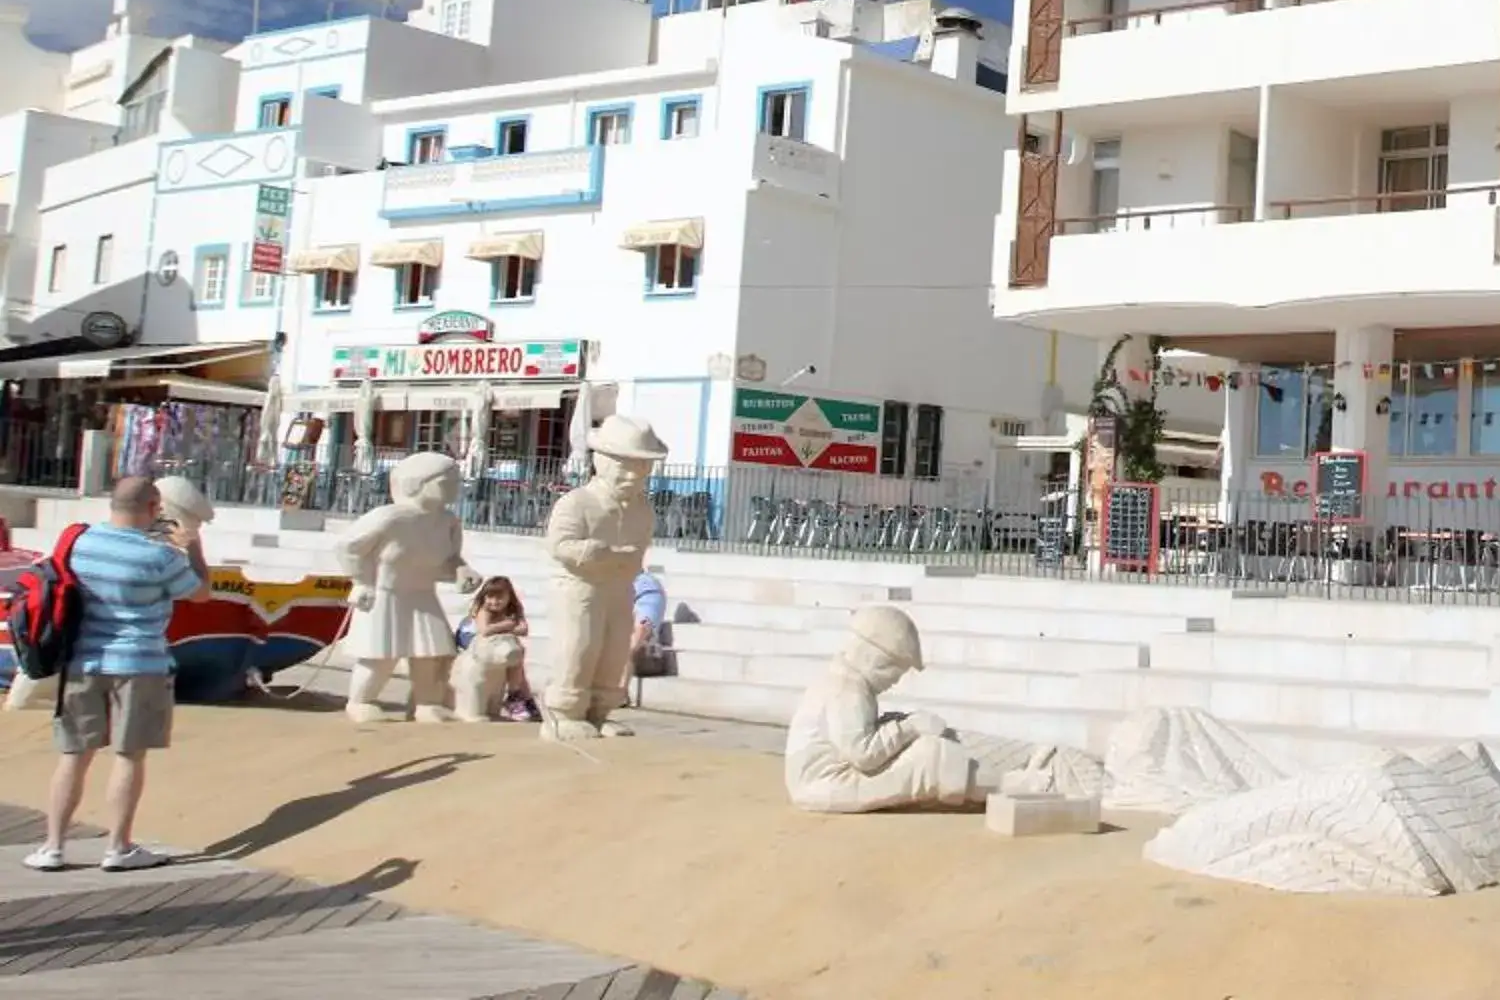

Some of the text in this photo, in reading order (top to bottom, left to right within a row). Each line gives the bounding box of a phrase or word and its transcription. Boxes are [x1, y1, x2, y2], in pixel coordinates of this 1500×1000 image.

[384, 351, 405, 376] MI
[421, 347, 523, 375] SOMBRERO
[742, 399, 795, 409] BURRITOS
[842, 413, 873, 422] TACOS
[742, 447, 784, 458] FAJITAS
[829, 456, 869, 465] NACHOS
